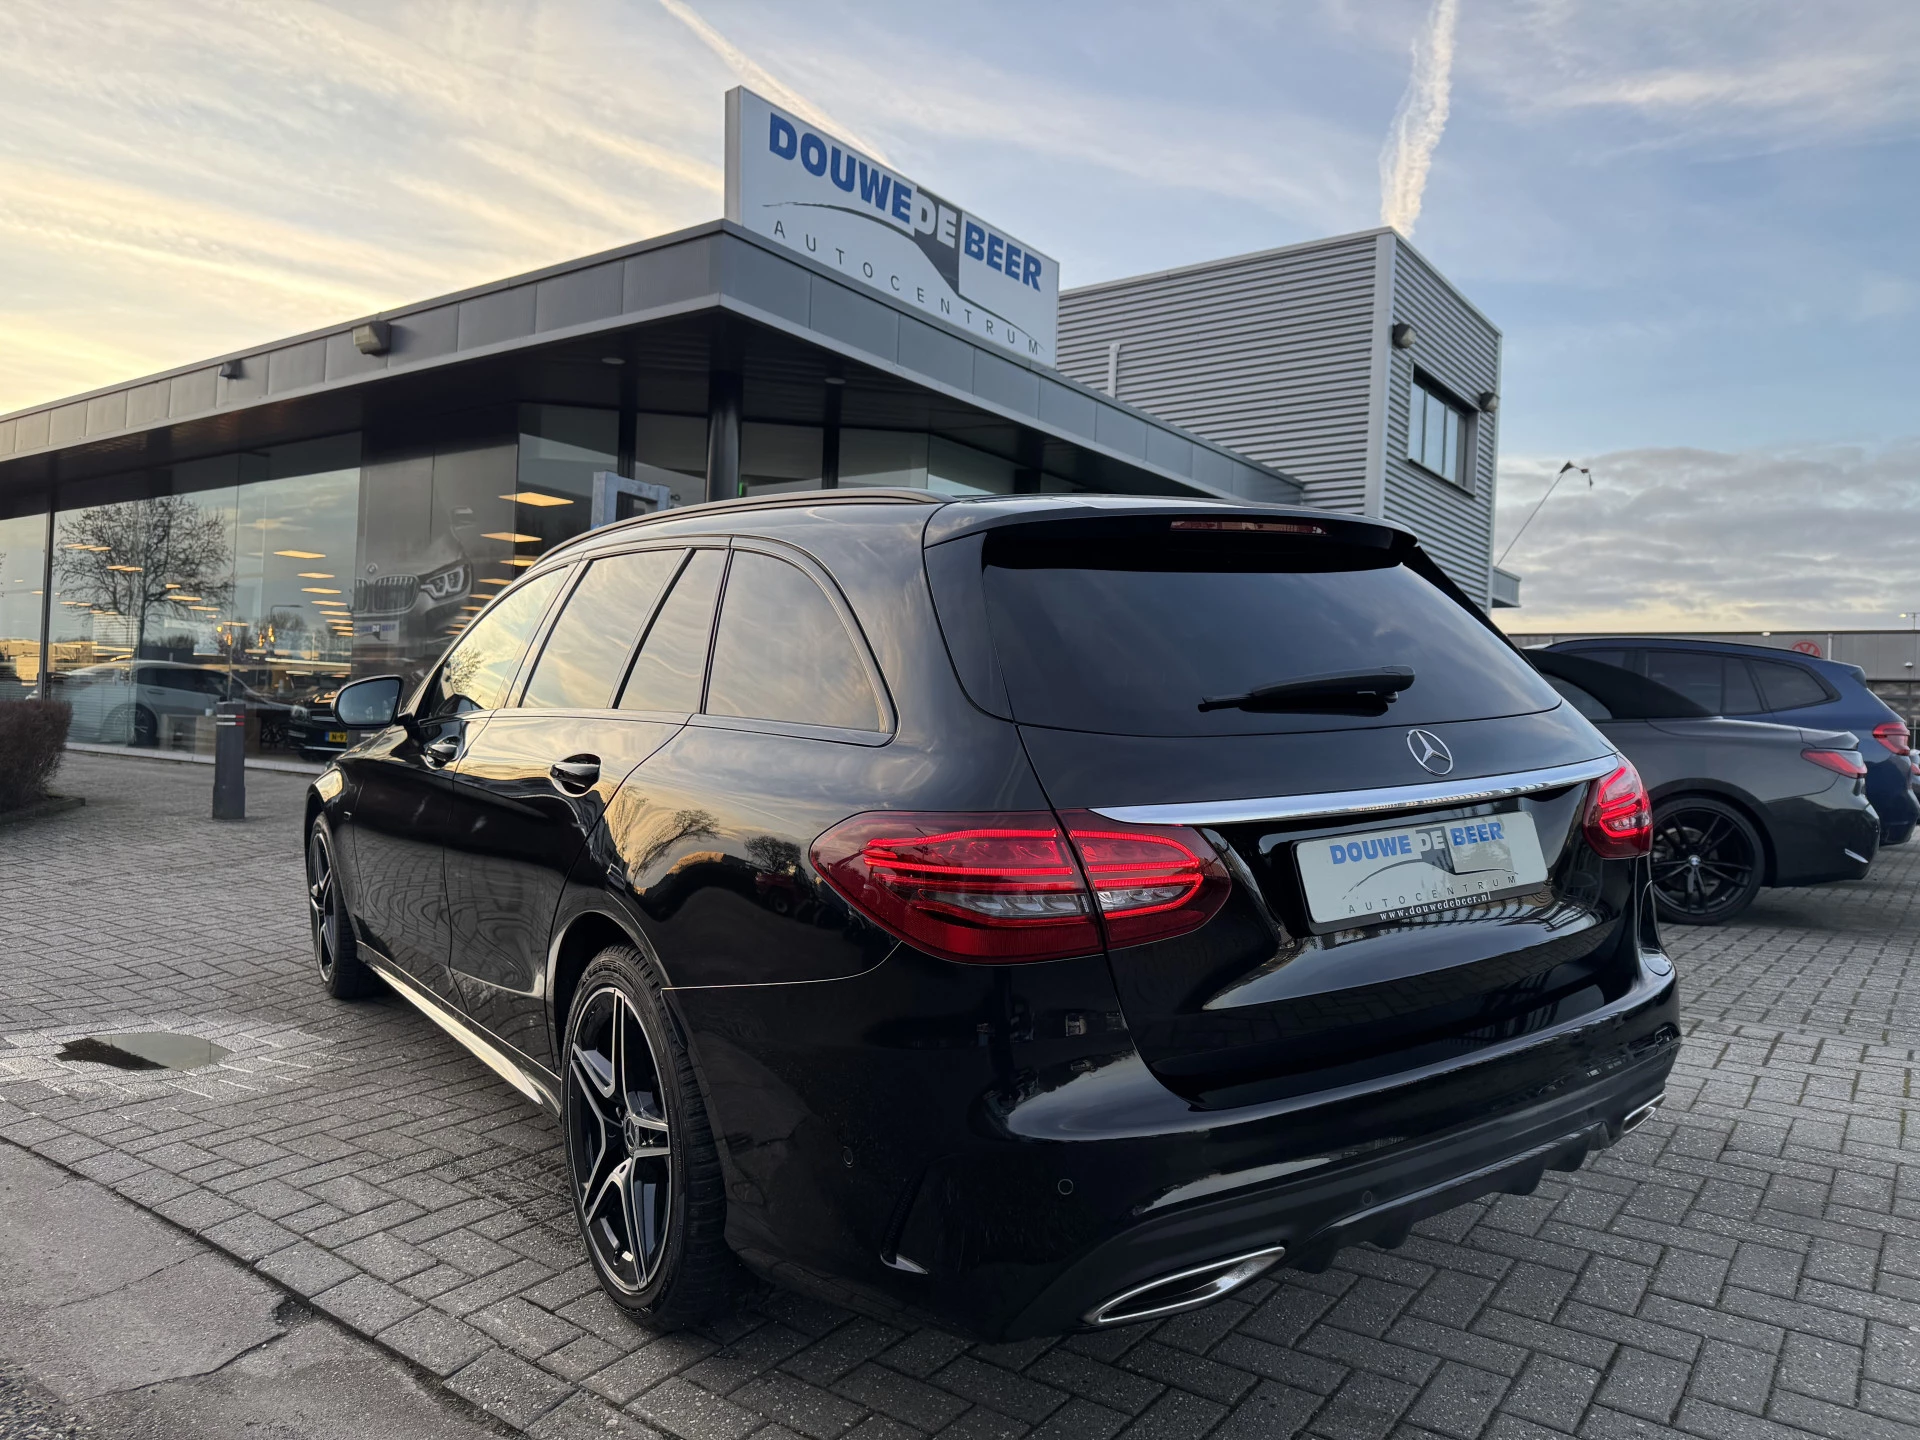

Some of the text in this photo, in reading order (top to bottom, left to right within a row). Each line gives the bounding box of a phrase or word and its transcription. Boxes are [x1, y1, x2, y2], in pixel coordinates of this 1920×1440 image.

[769, 112, 1041, 292] DOUWE DE BEER
[774, 220, 1039, 355] AUTOCENTRUM
[1329, 822, 1504, 865] DOUWE DE BEER
[1348, 876, 1516, 914] AUTOCENTRUM
[1380, 892, 1492, 921] www.douwedebeer.nl
